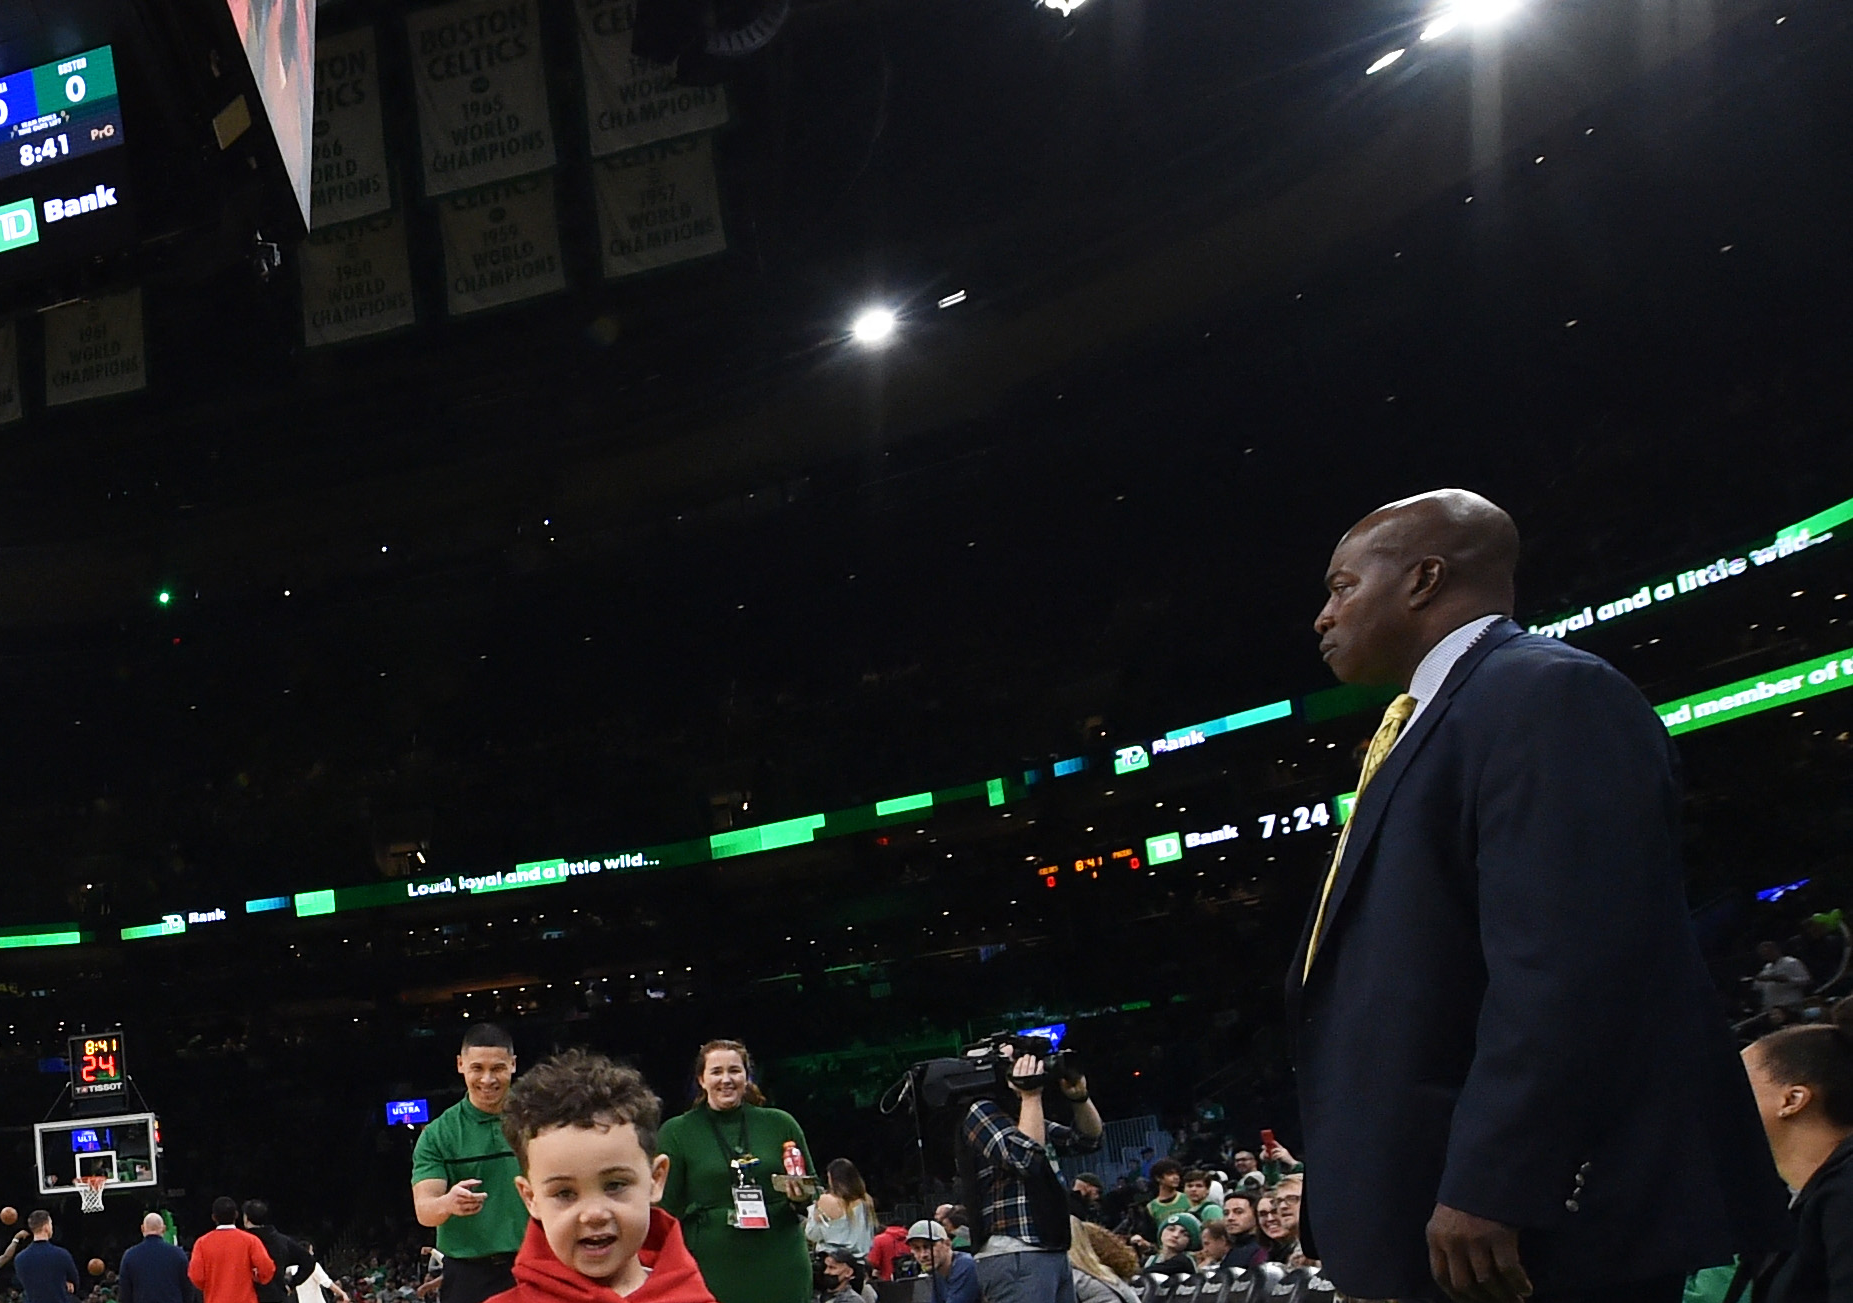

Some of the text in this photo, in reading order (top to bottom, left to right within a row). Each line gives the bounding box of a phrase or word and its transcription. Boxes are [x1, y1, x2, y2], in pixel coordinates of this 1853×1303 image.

[420, 6, 528, 54] BOSTON
[315, 50, 367, 81] TON
[428, 35, 527, 82] CELTICS
[65, 75, 86, 102] 0
[315, 79, 366, 115] TICS
[598, 87, 717, 132] CHAMPIONS
[20, 134, 69, 166] 8:41
[90, 125, 114, 140] PrG
[451, 116, 520, 146] WORLD
[432, 131, 545, 173] CHAMPIONS
[312, 159, 357, 188] ORLD
[44, 185, 117, 223] Bank
[312, 175, 381, 207] MPIONS
[628, 204, 692, 233] WORLD
[610, 217, 717, 259] CHAMPIONS
[472, 241, 534, 271] WORLD
[328, 279, 385, 305] WORLD
[453, 257, 556, 297] CHAMPIONS
[313, 295, 408, 328] CHAMPIONS
[69, 340, 121, 367] WORLD
[52, 354, 139, 388] CHAMPIONS
[1596, 586, 1652, 621] and
[1653, 582, 1675, 602] a
[1676, 557, 1748, 594] little
[1693, 674, 1805, 718] member
[1808, 660, 1839, 685] of
[1151, 728, 1206, 755] Bank
[1150, 837, 1179, 859] TD
[1185, 824, 1239, 849] Bank
[1258, 802, 1331, 840] 7:24
[406, 852, 661, 898] Loud, loyal and a little wild...
[188, 908, 227, 924] Bank
[85, 1038, 117, 1055] 8:41
[82, 1054, 115, 1082] 24
[88, 1081, 123, 1093] TISSOT
[392, 1106, 421, 1115] ULTRA
